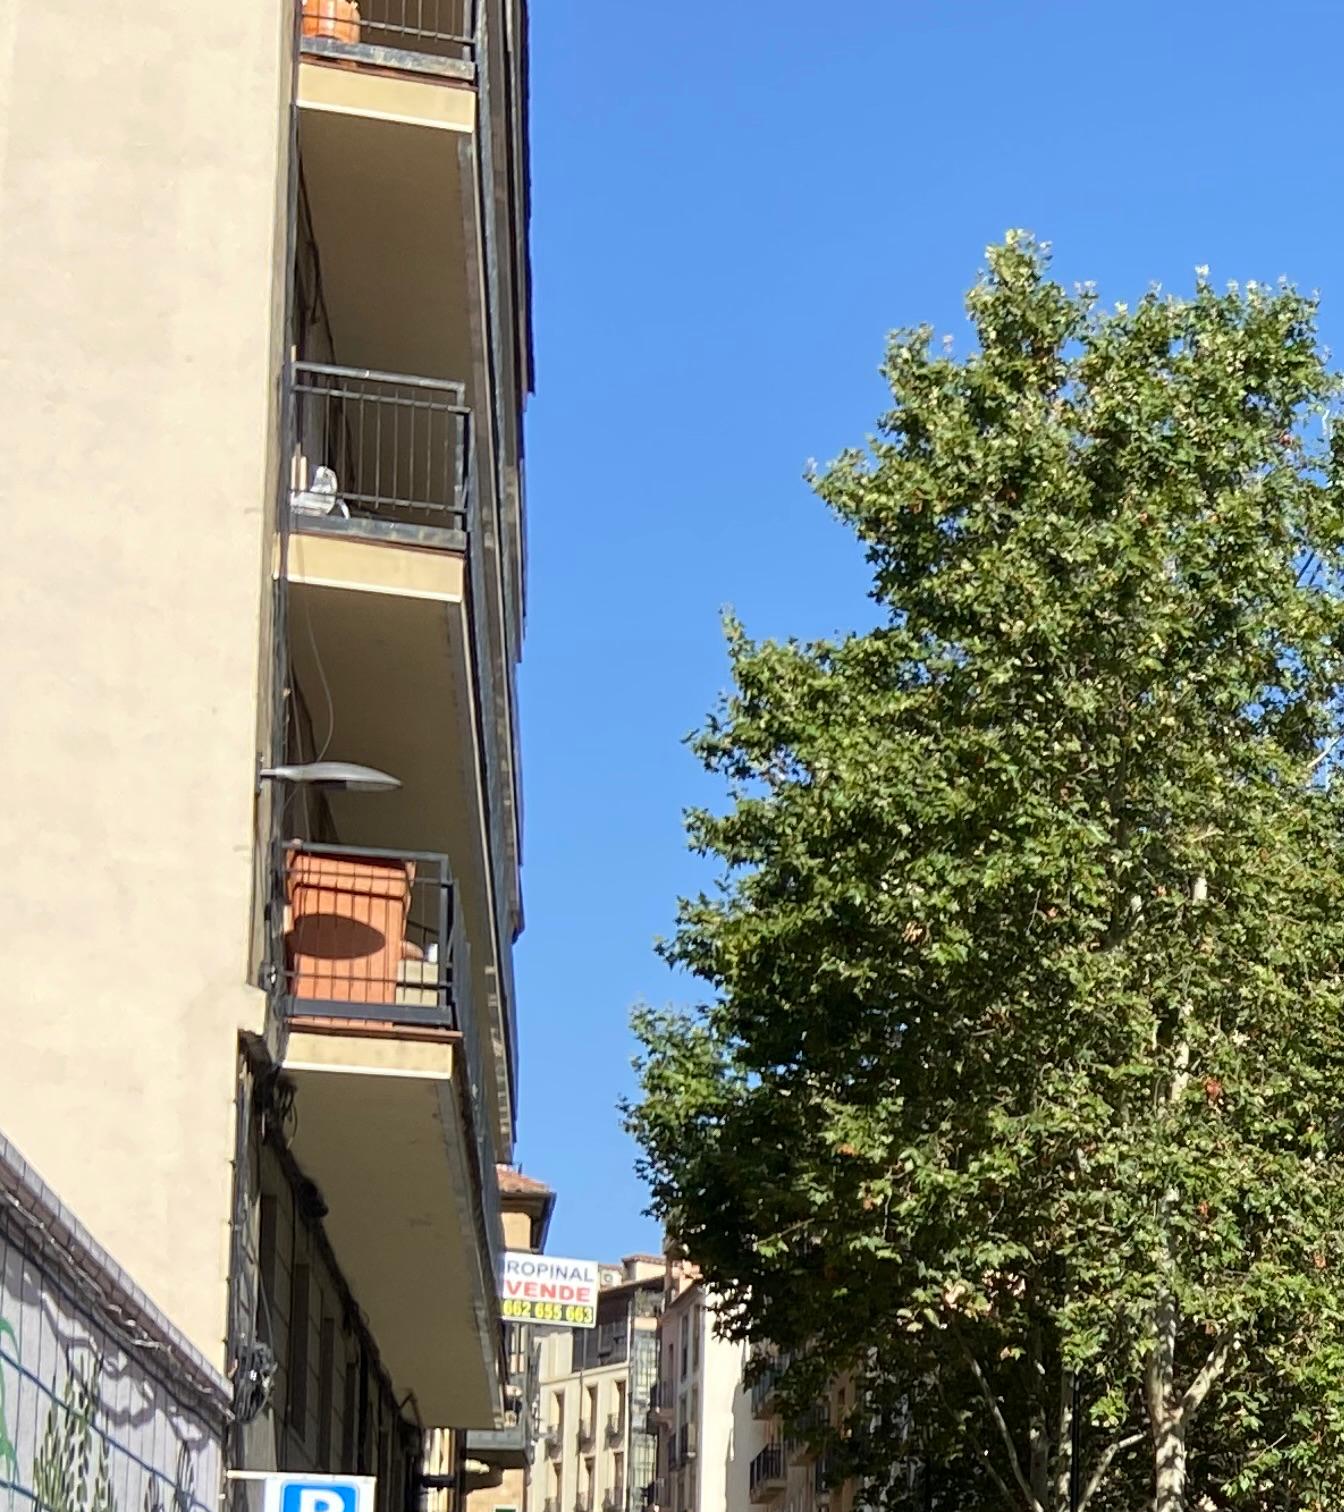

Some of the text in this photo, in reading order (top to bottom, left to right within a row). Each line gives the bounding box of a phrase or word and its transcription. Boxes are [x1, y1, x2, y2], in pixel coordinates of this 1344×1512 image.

[505, 1280, 591, 1302] VENDE
[503, 1299, 592, 1324] 662 655 663
